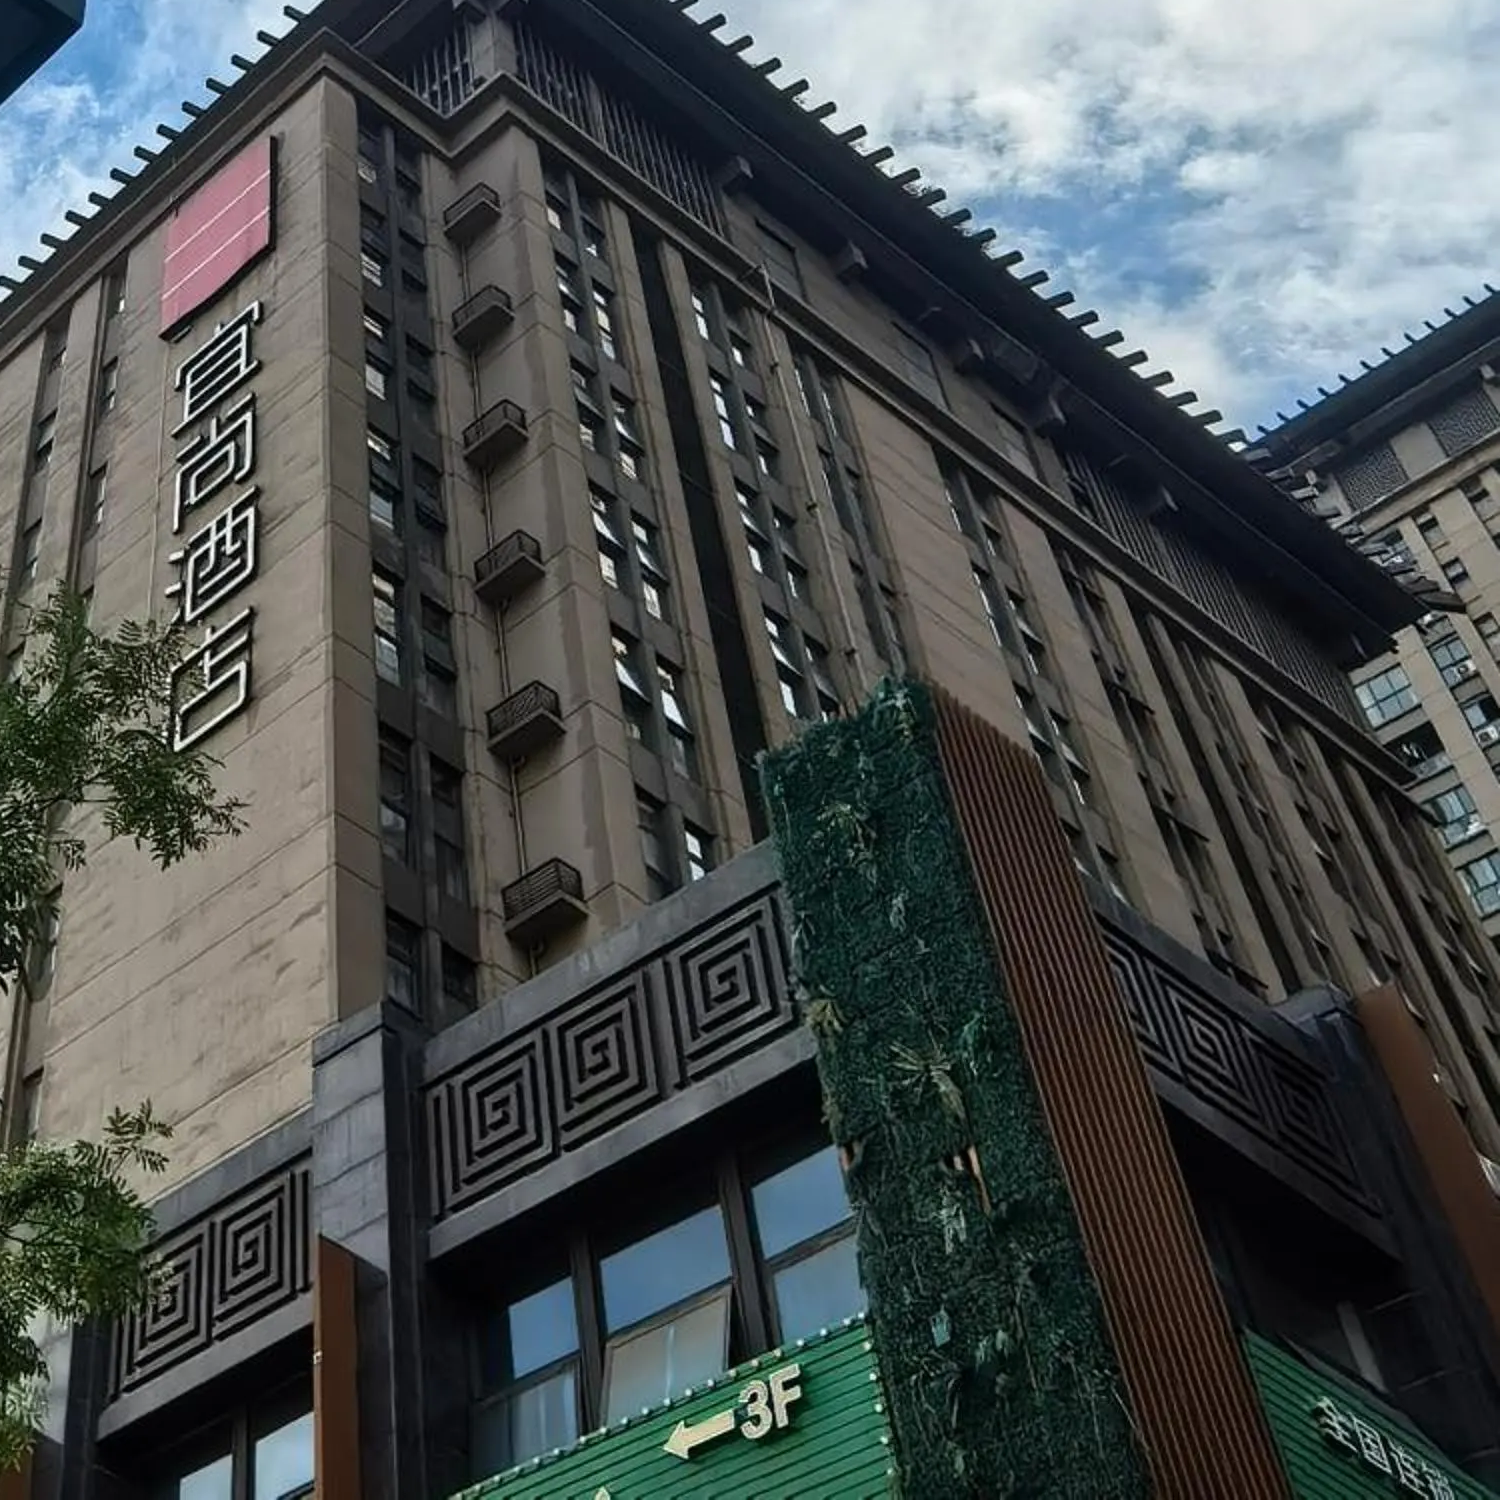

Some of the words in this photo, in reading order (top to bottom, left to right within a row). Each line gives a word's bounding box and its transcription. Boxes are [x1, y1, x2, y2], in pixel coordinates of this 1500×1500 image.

[165, 299, 261, 751] 宜尚酒店
[738, 1363, 802, 1440] 3F
